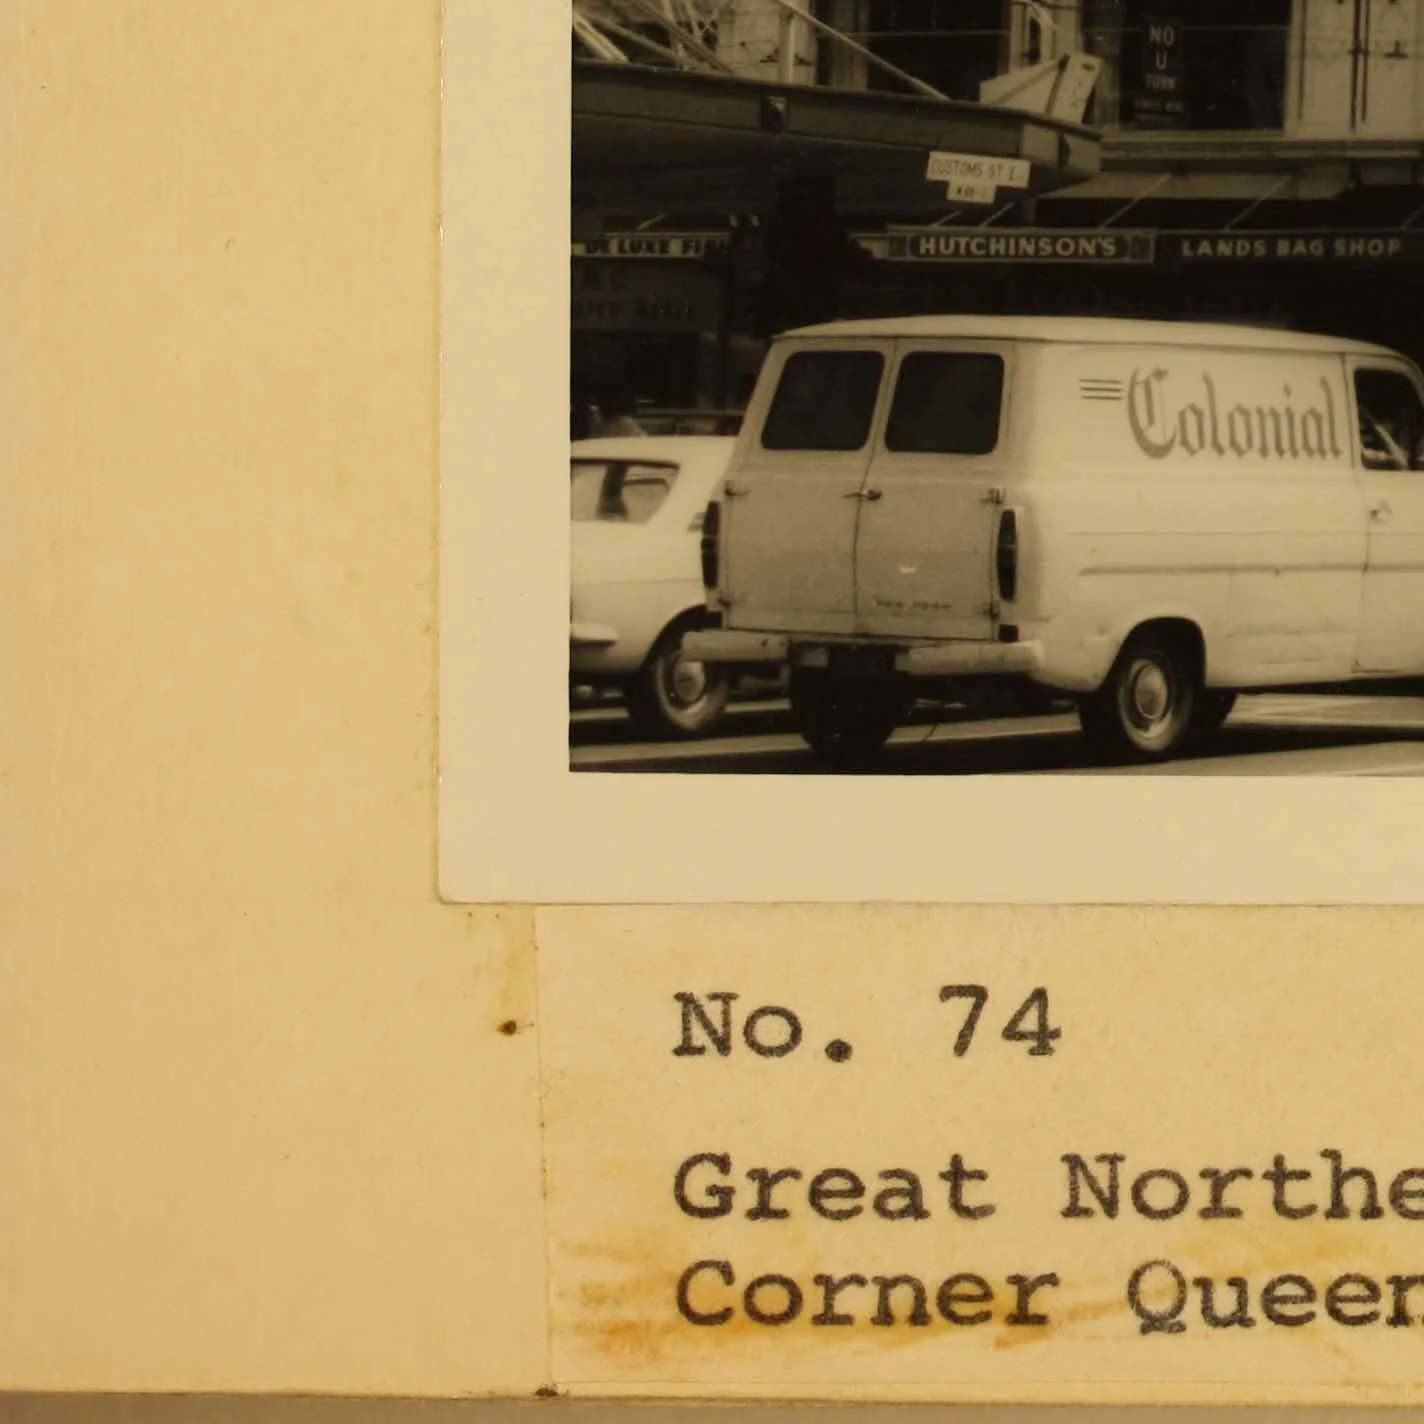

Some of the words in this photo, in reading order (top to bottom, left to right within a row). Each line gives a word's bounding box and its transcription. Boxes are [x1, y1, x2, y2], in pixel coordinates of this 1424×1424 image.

[1148, 24, 1175, 46] NO
[1155, 50, 1168, 70] U
[930, 157, 983, 178] CUSTOMS
[986, 162, 1004, 181] ST
[617, 239, 670, 256] LUXE
[918, 234, 1118, 258] HUTCHINSON'S
[1181, 234, 1267, 257] LANDS
[1276, 234, 1325, 257] BAG
[1334, 233, 1403, 257] SHOP
[1127, 364, 1343, 460] Colonial
[673, 991, 852, 1063] No.
[939, 984, 1061, 1057] 74
[673, 1152, 995, 1222] Great
[675, 1260, 1060, 1328] Corner
